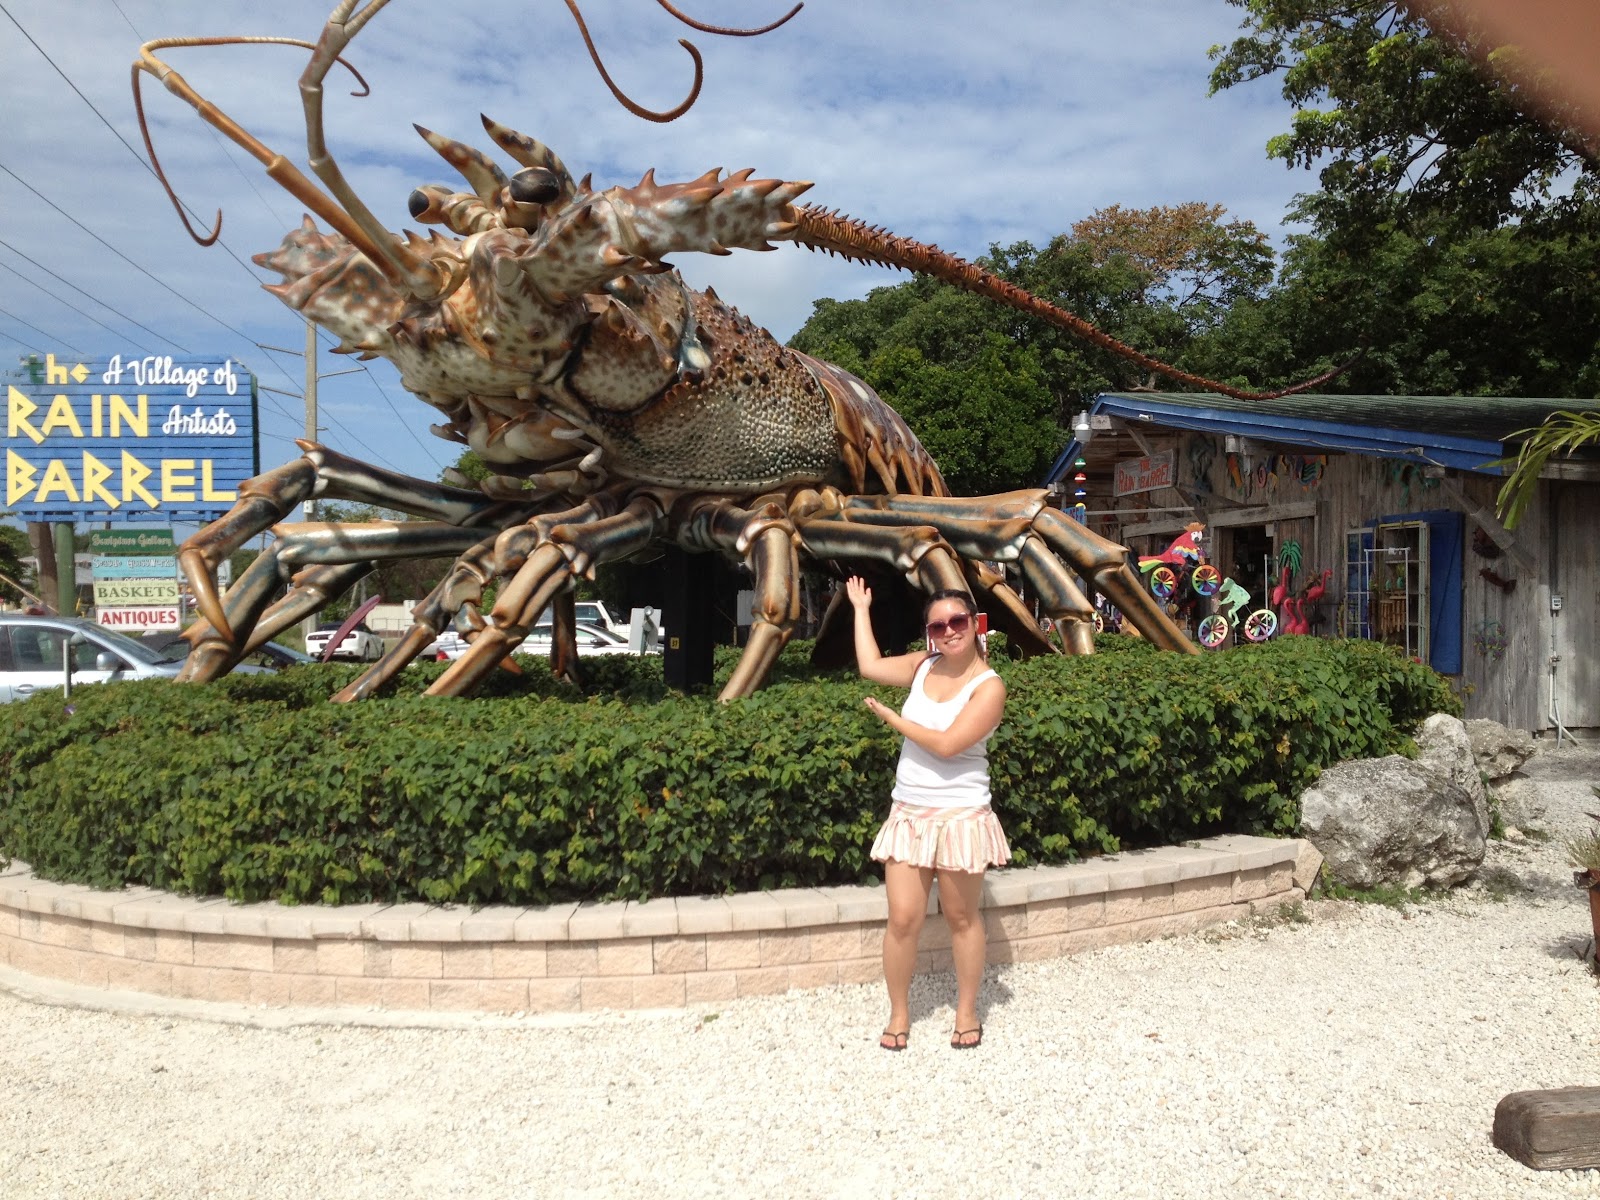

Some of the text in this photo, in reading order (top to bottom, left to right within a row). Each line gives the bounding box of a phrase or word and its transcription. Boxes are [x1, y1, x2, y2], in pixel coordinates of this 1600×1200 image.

[102, 354, 237, 398] A Village of
[7, 385, 148, 445] RAIN
[162, 405, 236, 435] Artists
[7, 448, 237, 509] BARREL
[97, 586, 176, 598] BASKETS
[100, 610, 177, 626] ANTIQUES
